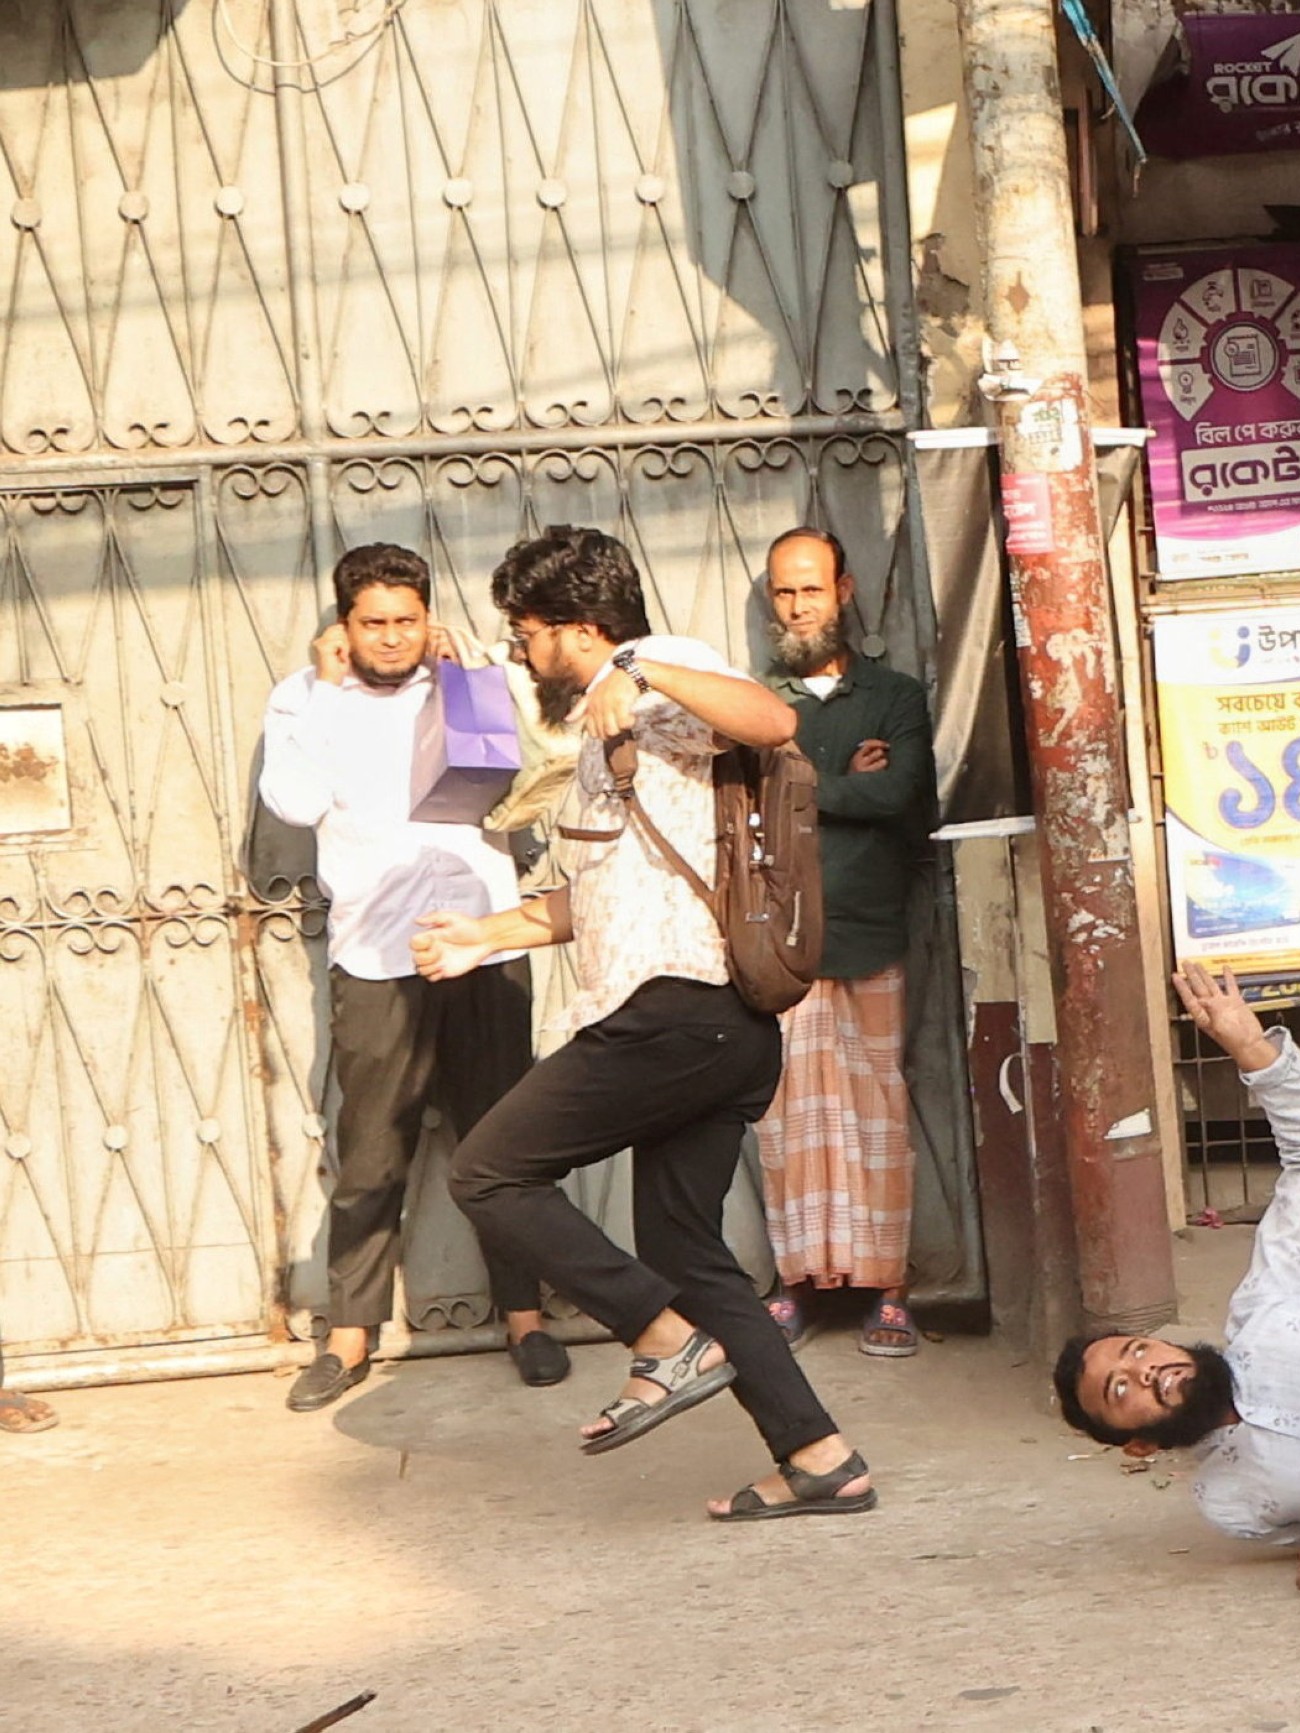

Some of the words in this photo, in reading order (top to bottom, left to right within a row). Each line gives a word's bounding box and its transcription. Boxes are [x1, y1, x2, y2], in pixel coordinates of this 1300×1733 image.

[1195, 421, 1232, 445] বিল
[1236, 423, 1256, 444] পে
[1216, 692, 1287, 713] সবচেয়ে
